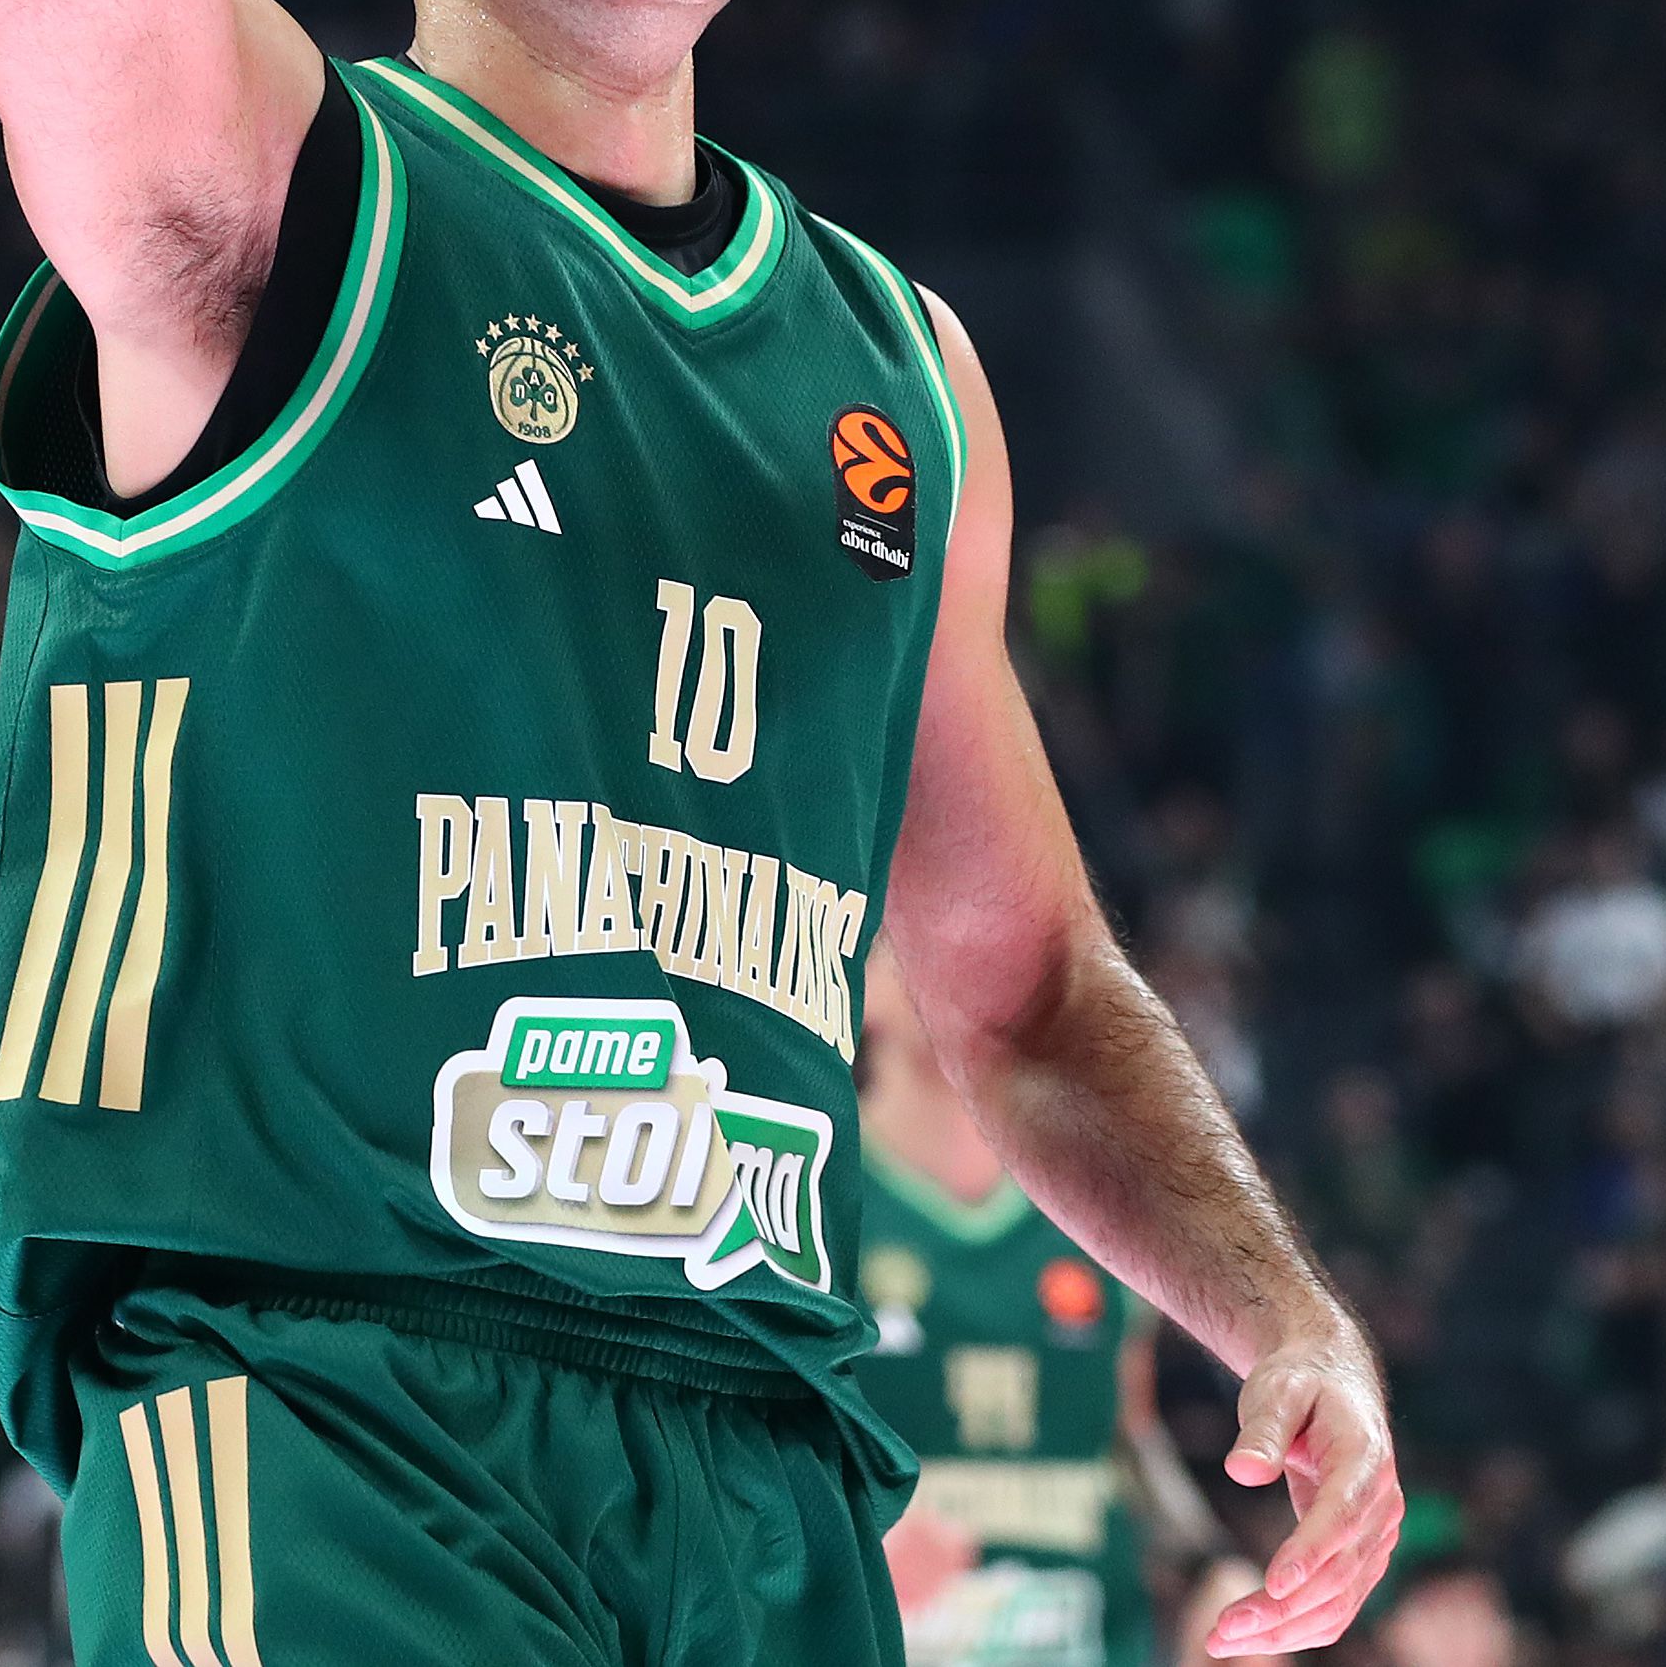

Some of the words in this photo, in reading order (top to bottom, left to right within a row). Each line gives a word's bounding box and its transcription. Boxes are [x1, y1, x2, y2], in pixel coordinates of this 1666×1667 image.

[518, 421, 551, 438] 1908
[841, 531, 870, 553] abu
[871, 541, 910, 570] dhabi
[649, 578, 762, 784] 10
[515, 1028, 661, 1080] pame
